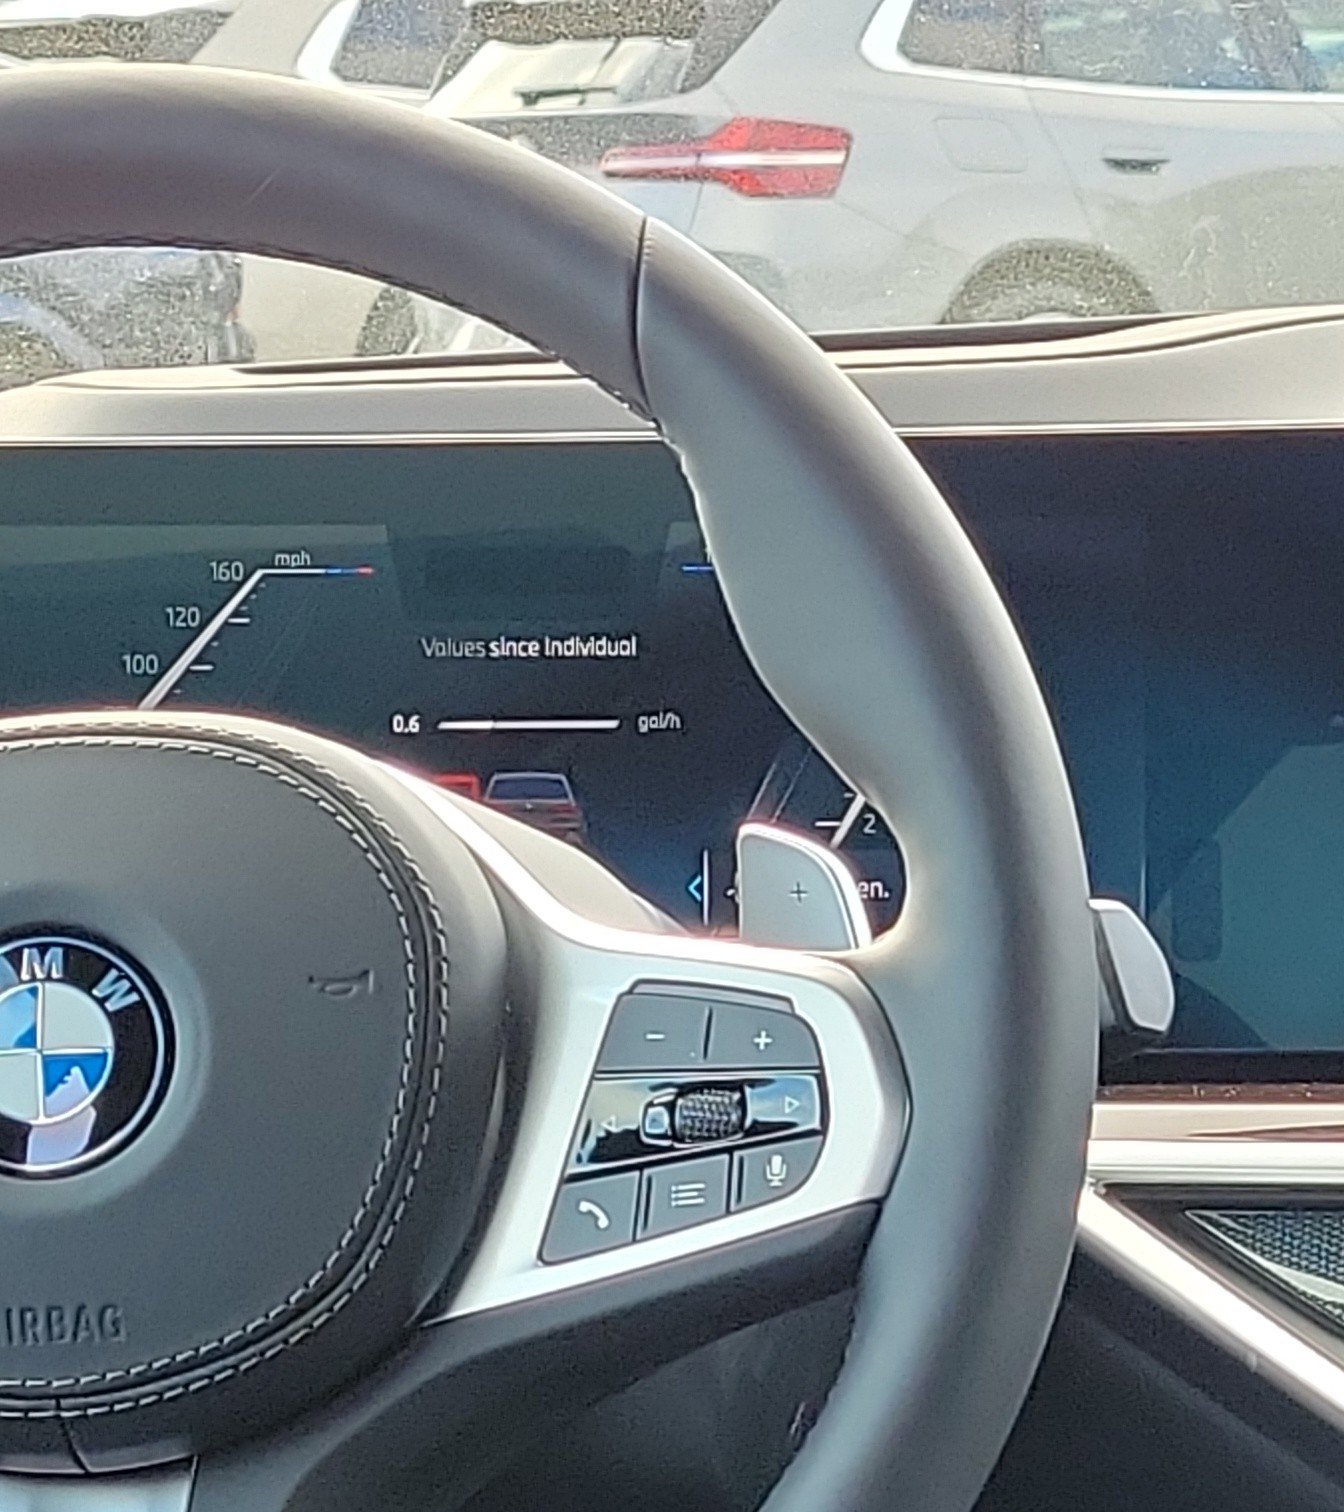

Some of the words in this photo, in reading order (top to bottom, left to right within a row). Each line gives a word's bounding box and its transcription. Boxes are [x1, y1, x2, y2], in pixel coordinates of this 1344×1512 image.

[274, 550, 311, 566] mph
[210, 561, 244, 582] 160
[166, 607, 200, 628] 120
[420, 637, 486, 658] Values
[488, 636, 540, 657] since
[544, 635, 637, 657] Individual
[122, 654, 158, 675] 100
[392, 714, 421, 734] 0.6
[637, 710, 682, 734] gal/h
[862, 813, 877, 835] 2
